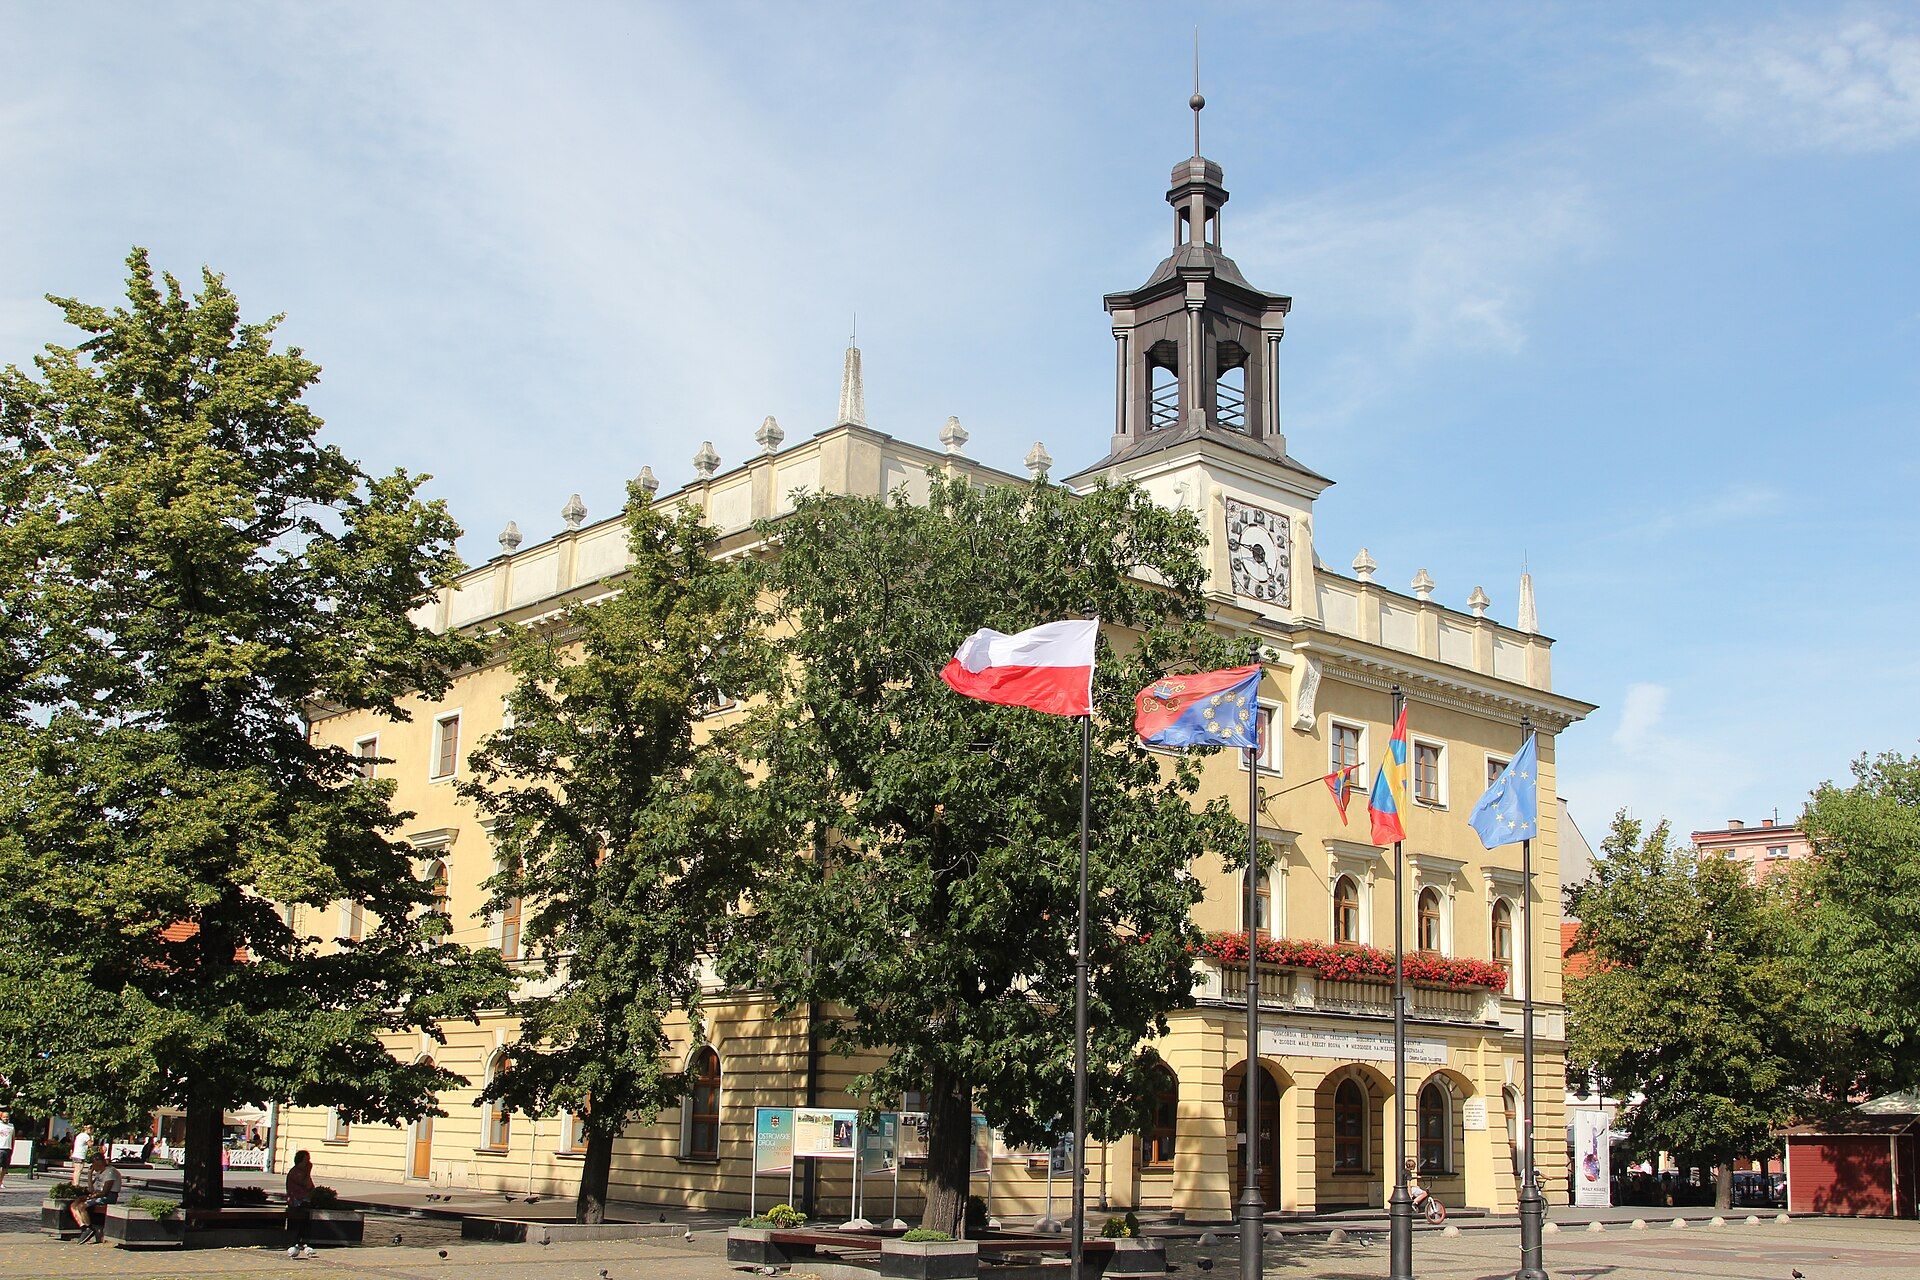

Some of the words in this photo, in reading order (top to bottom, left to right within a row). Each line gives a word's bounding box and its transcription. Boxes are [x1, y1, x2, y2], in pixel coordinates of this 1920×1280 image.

[1240, 510, 1248, 524] 11
[1254, 510, 1265, 524] 12
[1232, 522, 1242, 535] 10
[1269, 518, 1274, 532] 1
[1228, 538, 1239, 551] 9
[1277, 535, 1285, 549] 2
[1233, 558, 1242, 571] 8
[1280, 555, 1289, 568] 3
[1243, 575, 1250, 590] 7
[1276, 573, 1285, 587] 4
[1255, 585, 1264, 598] 6
[1268, 585, 1276, 598] 5
